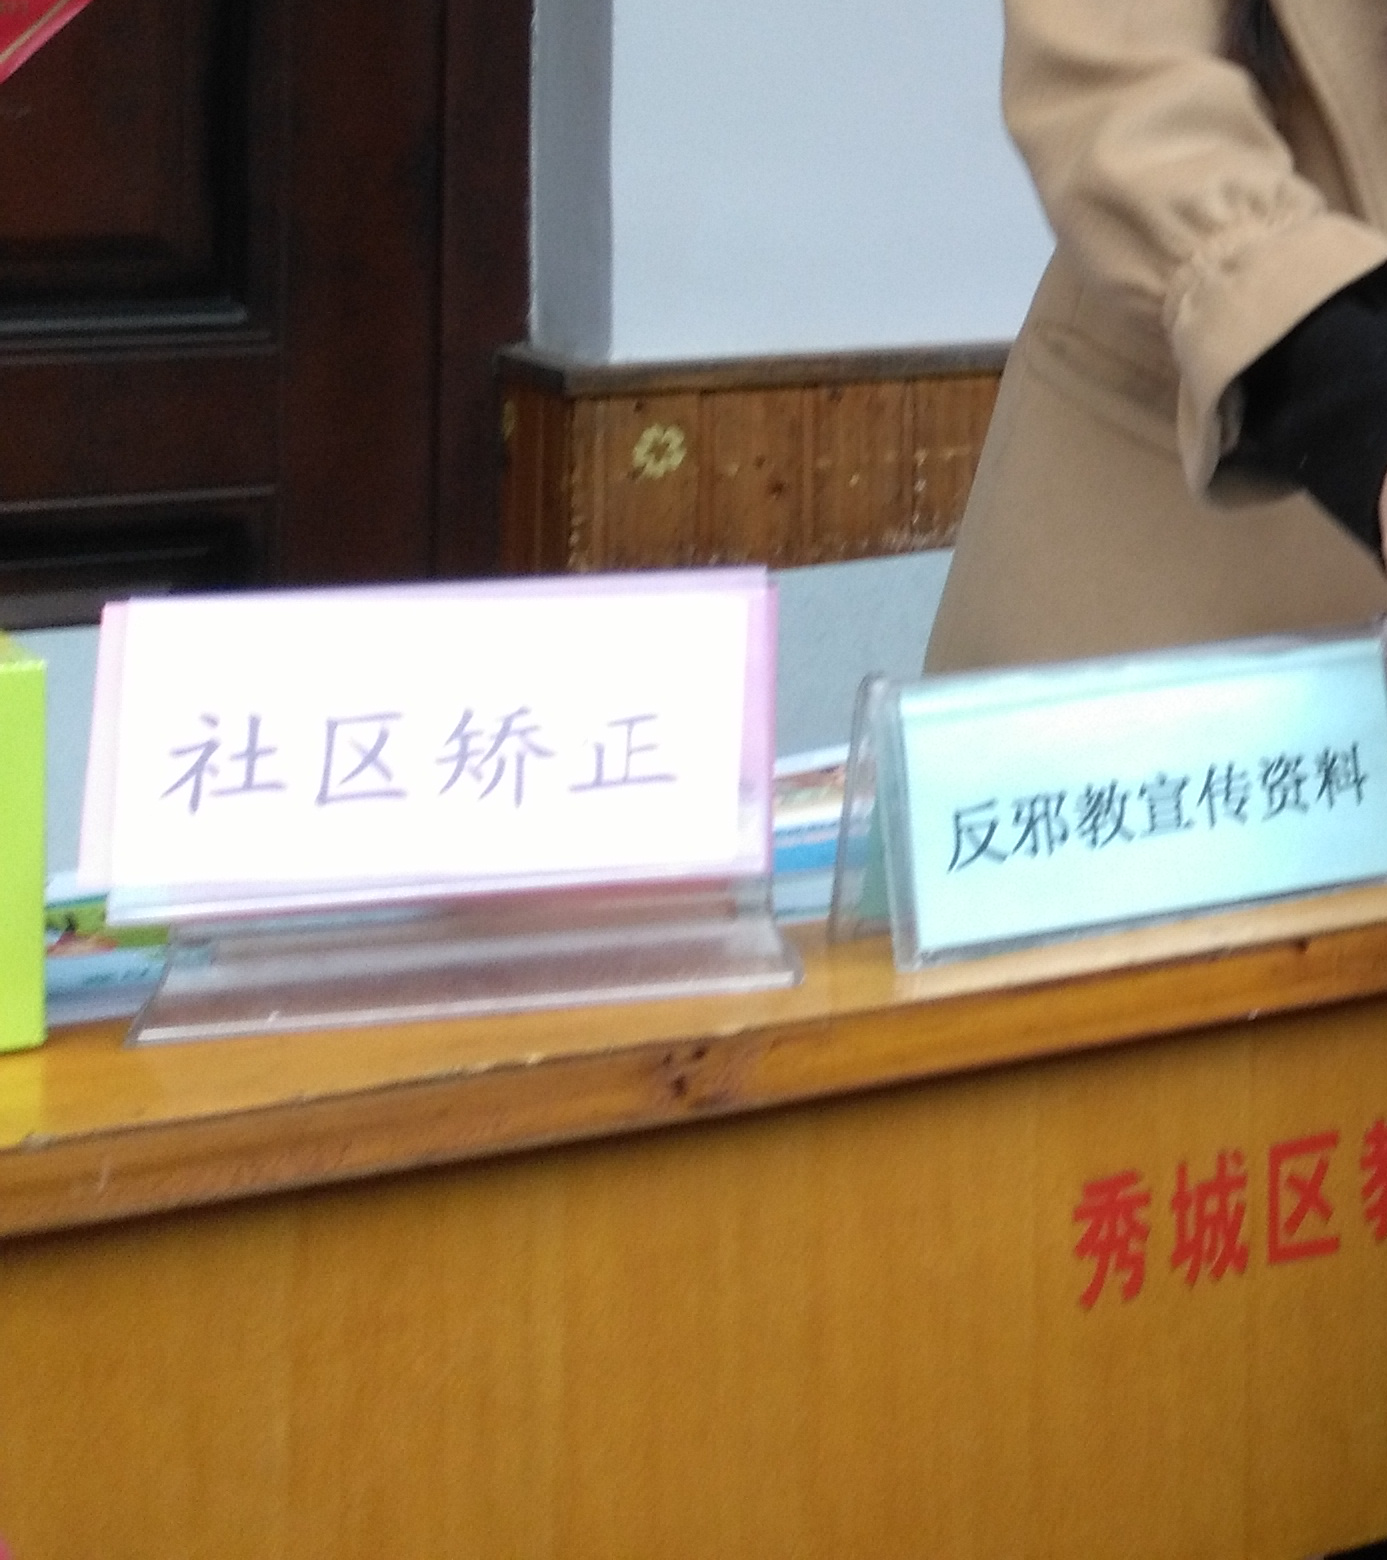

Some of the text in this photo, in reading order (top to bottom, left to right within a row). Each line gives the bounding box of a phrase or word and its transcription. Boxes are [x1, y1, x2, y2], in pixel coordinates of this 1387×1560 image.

[161, 706, 677, 815] 社区矫正
[946, 742, 1370, 874] 反邪教宣传资料
